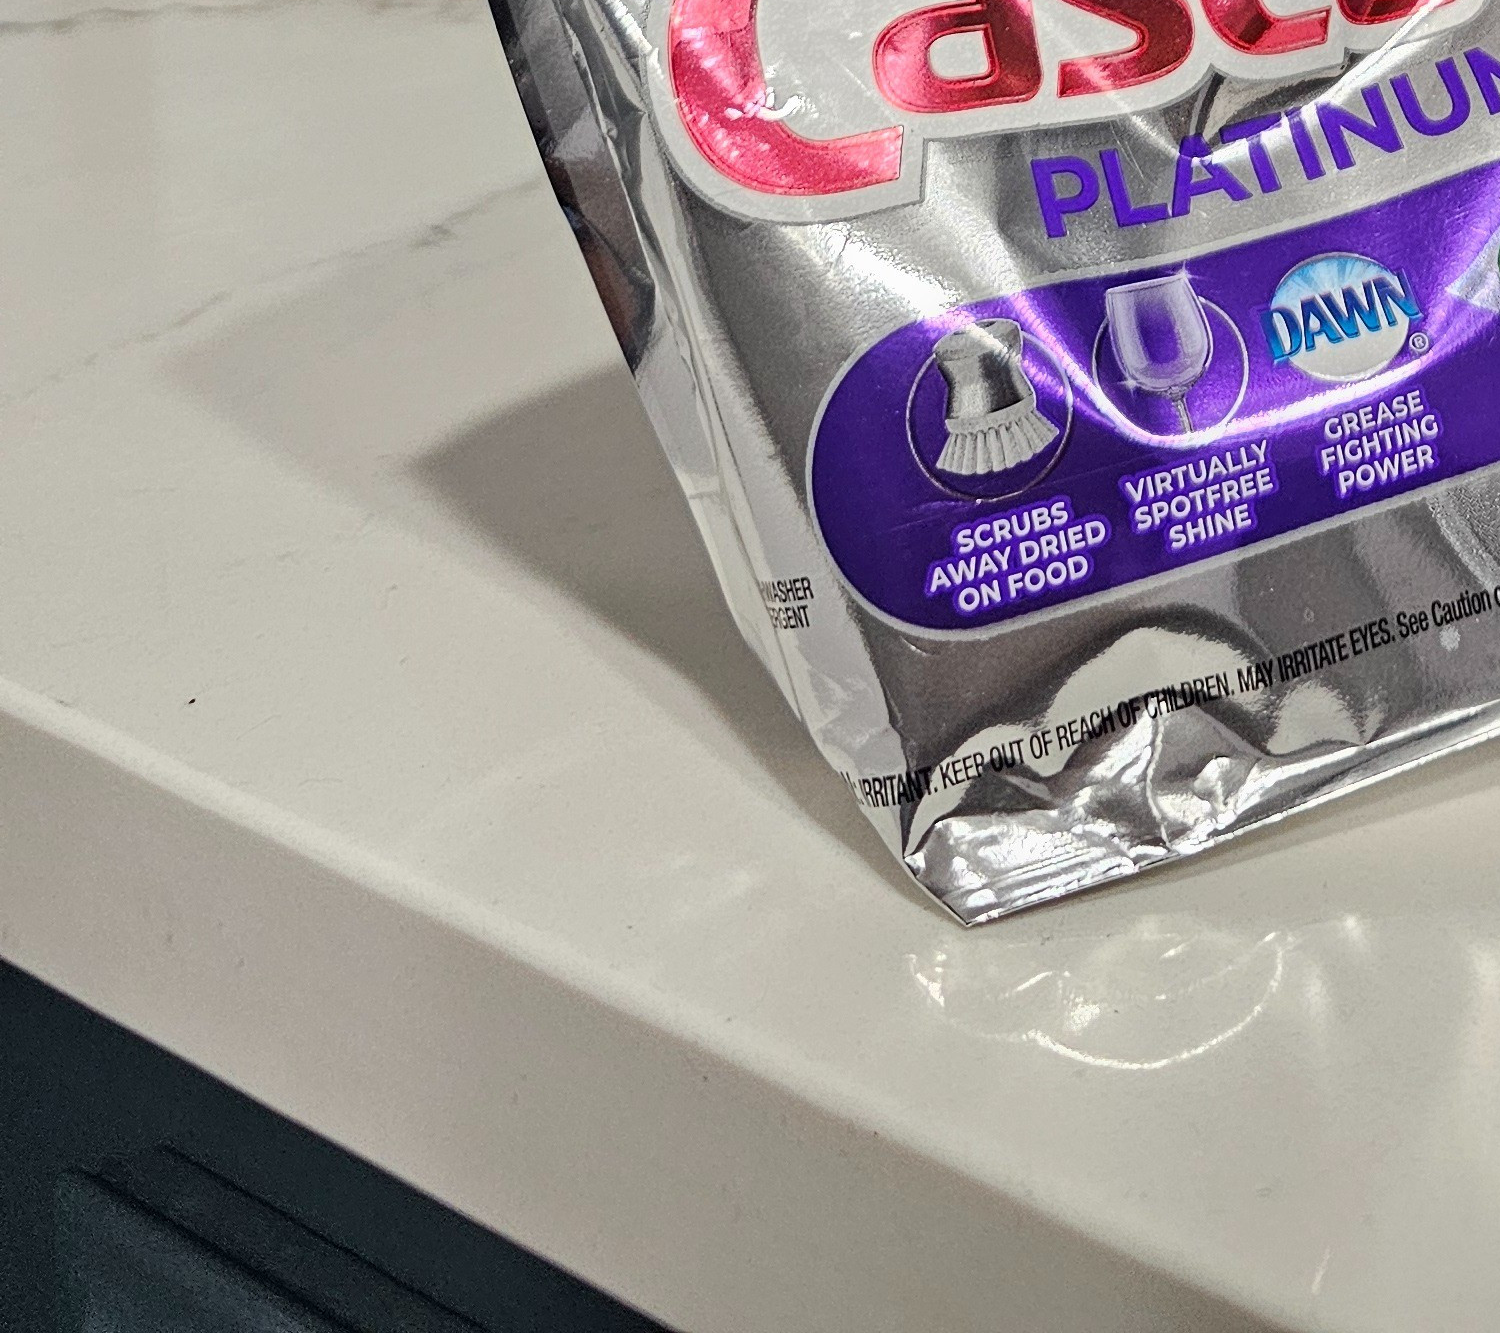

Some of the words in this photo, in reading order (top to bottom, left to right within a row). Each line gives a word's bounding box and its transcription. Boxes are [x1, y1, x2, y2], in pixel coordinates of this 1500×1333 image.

[1320, 414, 1439, 472] FIGHTING
[1322, 389, 1424, 442] GREASE
[1124, 439, 1269, 504] VIRTUALLY
[1134, 468, 1274, 532] SPOTFREE
[1338, 444, 1435, 498] POWER
[928, 545, 1014, 593] AWAY
[1018, 519, 1107, 567] DRIED
[956, 500, 1069, 554] SCRUBS
[1169, 505, 1252, 550] SHINE
[957, 581, 1004, 614] ON
[1006, 553, 1091, 598] FOOD
[938, 751, 985, 790] KEEP
[989, 738, 1024, 773] OUT
[1028, 729, 1053, 760] OF
[1056, 704, 1116, 751] REACH
[1117, 695, 1142, 728] OF
[1144, 671, 1235, 720] CHILDREN.
[1237, 658, 1275, 694] MAY
[1277, 632, 1350, 684] IRRITATE
[1349, 616, 1396, 657] EYES.
[1396, 608, 1430, 640] See
[1431, 587, 1493, 628] Caution
